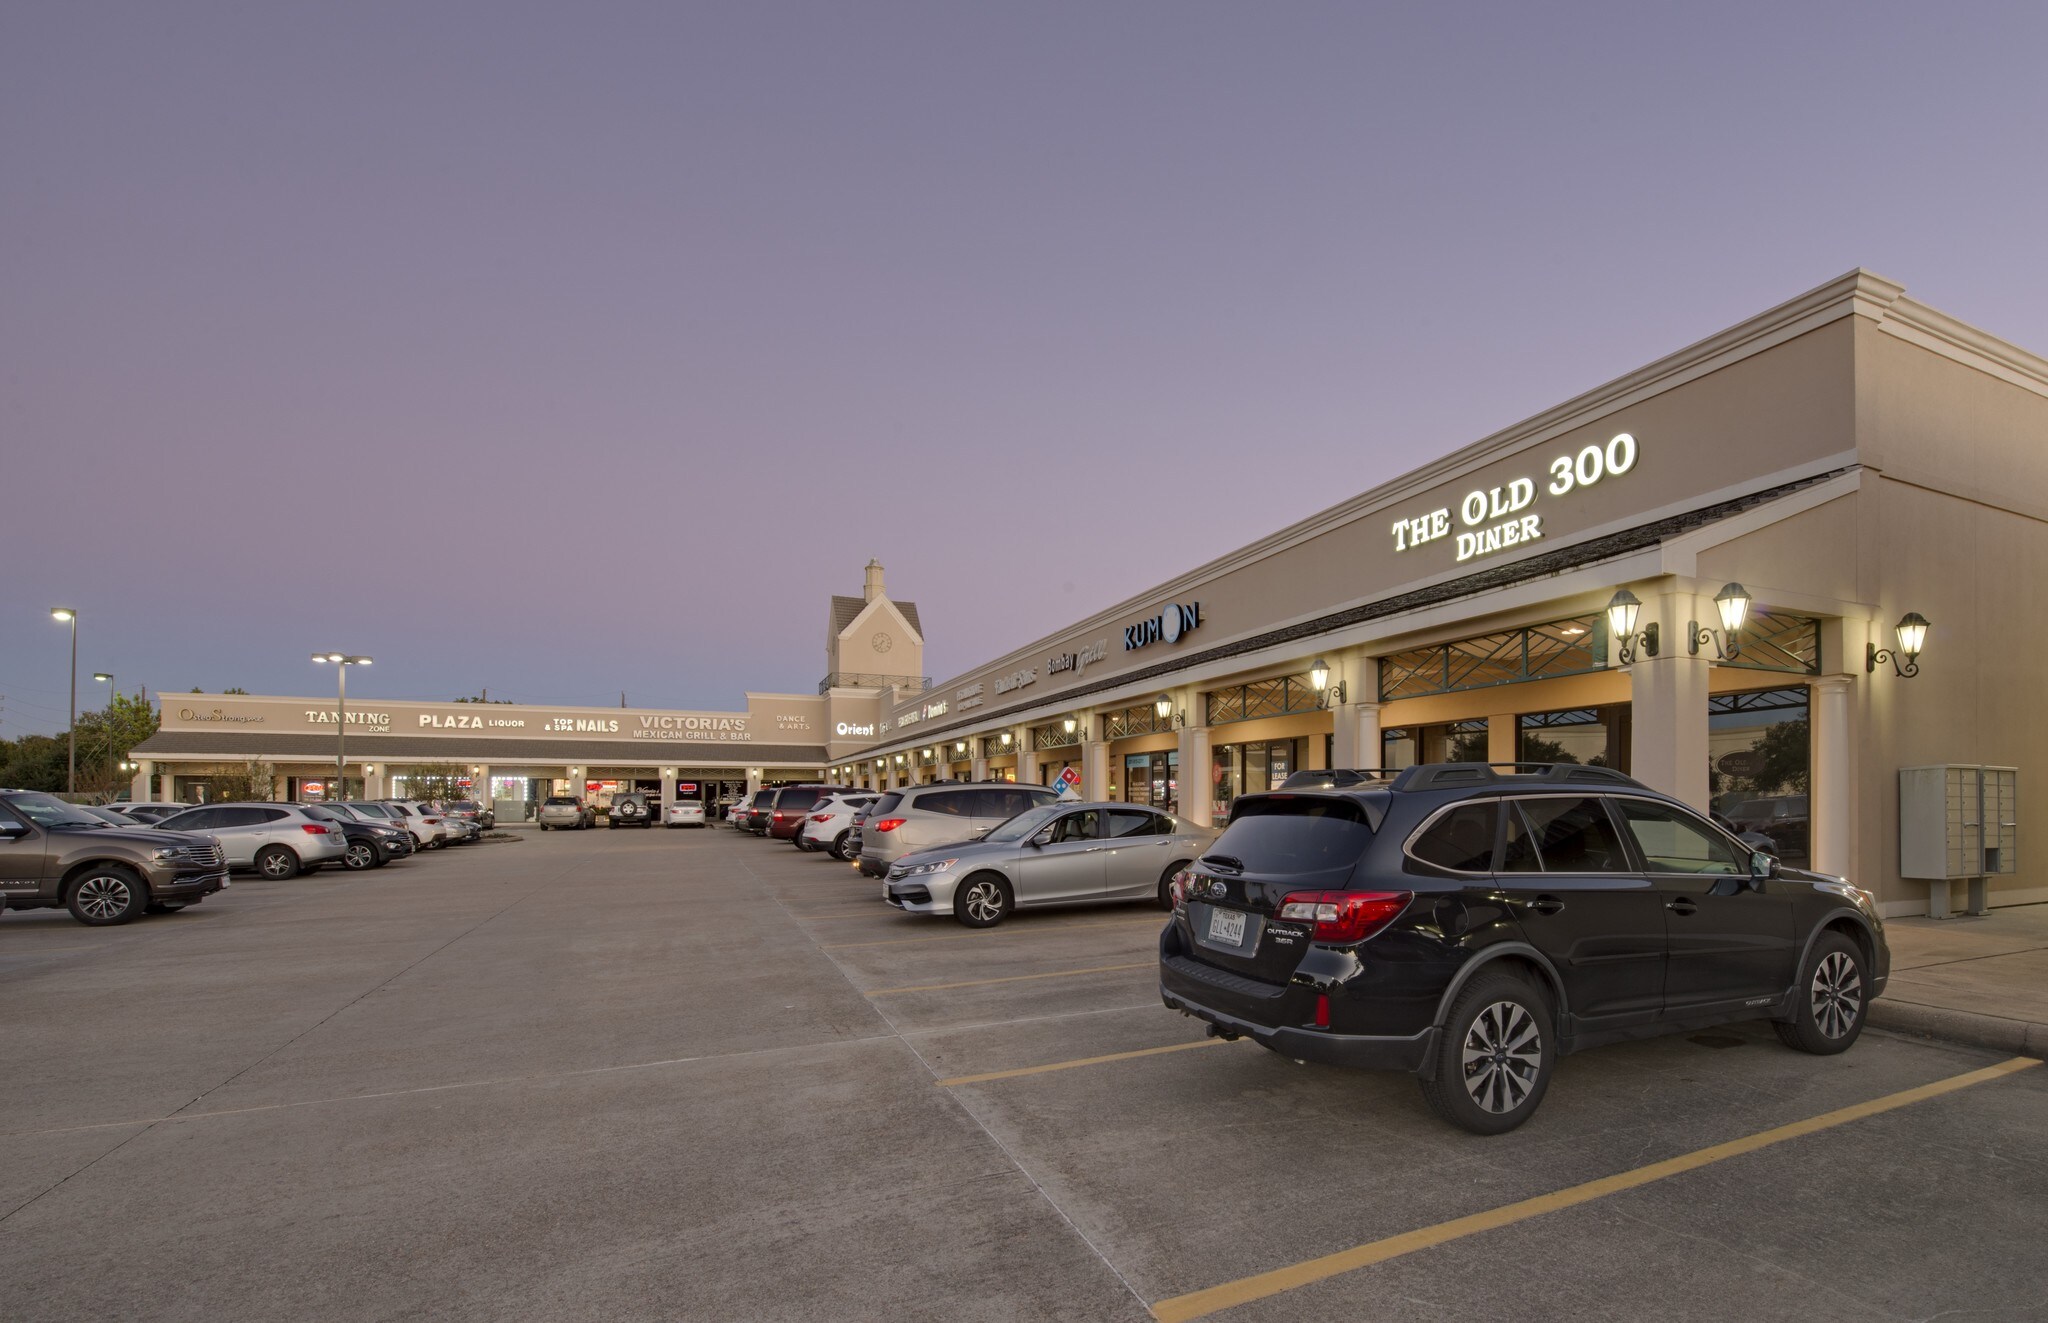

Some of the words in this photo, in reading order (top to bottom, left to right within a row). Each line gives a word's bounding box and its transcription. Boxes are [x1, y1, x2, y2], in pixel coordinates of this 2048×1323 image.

[1392, 508, 1450, 551] THE
[1461, 477, 1536, 526] OLD
[1549, 433, 1638, 495] 300
[1456, 514, 1543, 561] DINER
[1124, 602, 1199, 651] KUMON
[305, 711, 390, 724] TANNING
[419, 714, 483, 728] PLAZA
[488, 719, 525, 727] LIQUOR
[640, 716, 746, 731] VICTORIA'S
[576, 719, 619, 732] NAILS
[836, 722, 874, 736] Orient
[633, 730, 683, 739] MEXICAN
[686, 731, 717, 739] GRILL
[719, 732, 727, 740] &
[730, 732, 751, 740] BAR
[1274, 762, 1285, 770] FOR
[1271, 772, 1288, 780] LEASE
[1222, 912, 1237, 920] TEXAS
[1267, 928, 1304, 938] OUTBACK
